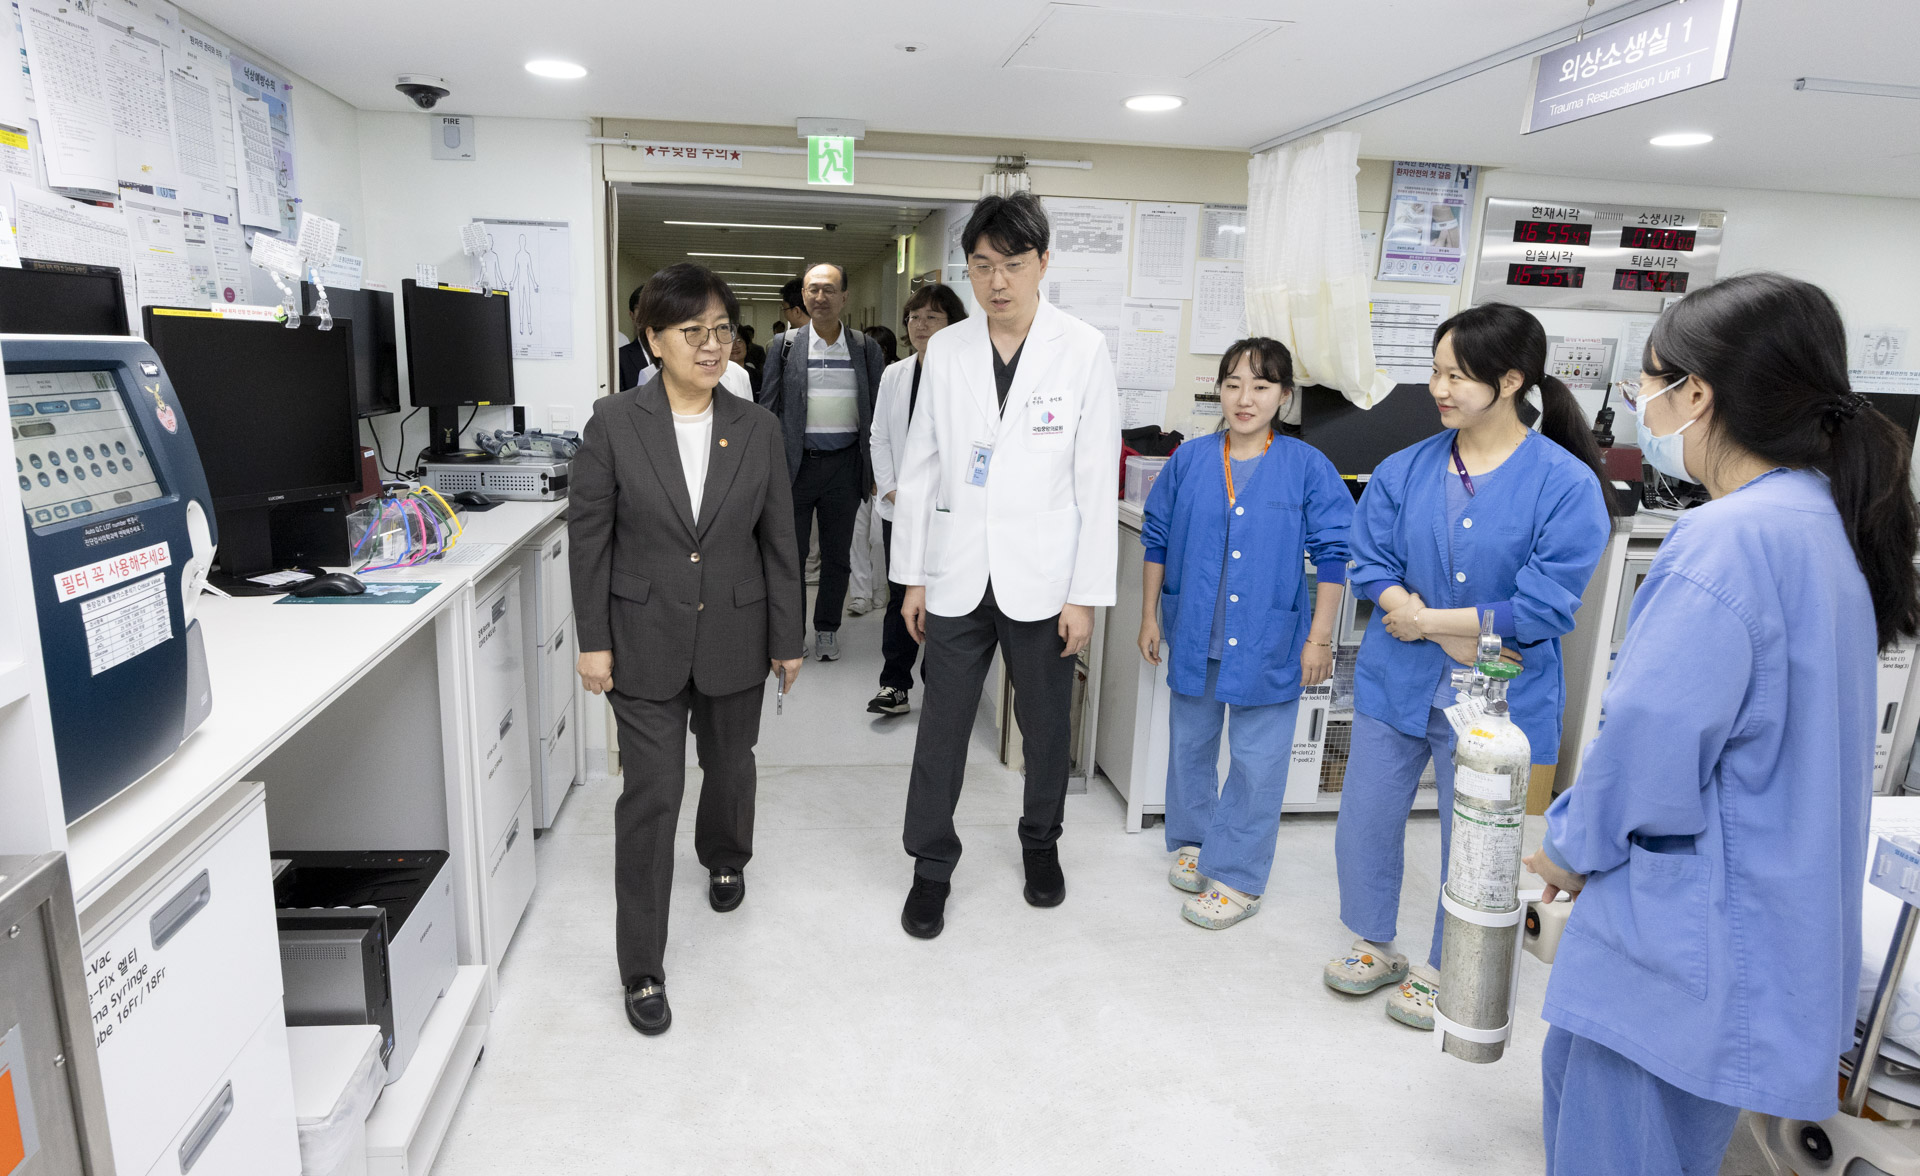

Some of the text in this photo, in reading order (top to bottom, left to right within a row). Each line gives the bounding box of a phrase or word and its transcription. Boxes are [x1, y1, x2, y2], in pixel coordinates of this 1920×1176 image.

[1558, 16, 1694, 83] 외상소생실 1
[244, 66, 276, 92] 낙상예방수칙
[1549, 63, 1692, 117] Trauma Resuscitation Unit 1
[702, 148, 728, 160] 주의
[1396, 168, 1452, 180] 환자안전의 첫 걸음
[1531, 206, 1580, 220] 현재시각
[1638, 212, 1684, 226] 소생시간
[1520, 224, 1538, 242] 16
[1546, 225, 1570, 243] 55
[1526, 249, 1573, 264] 입실시각
[1631, 255, 1678, 269] 퇴실시각
[1513, 266, 1530, 285] 16
[1540, 267, 1563, 286] 55
[60, 547, 169, 595] 필터 꼭 사용해주세요.
[118, 948, 137, 976] 엘티
[111, 964, 148, 1008] Syringe
